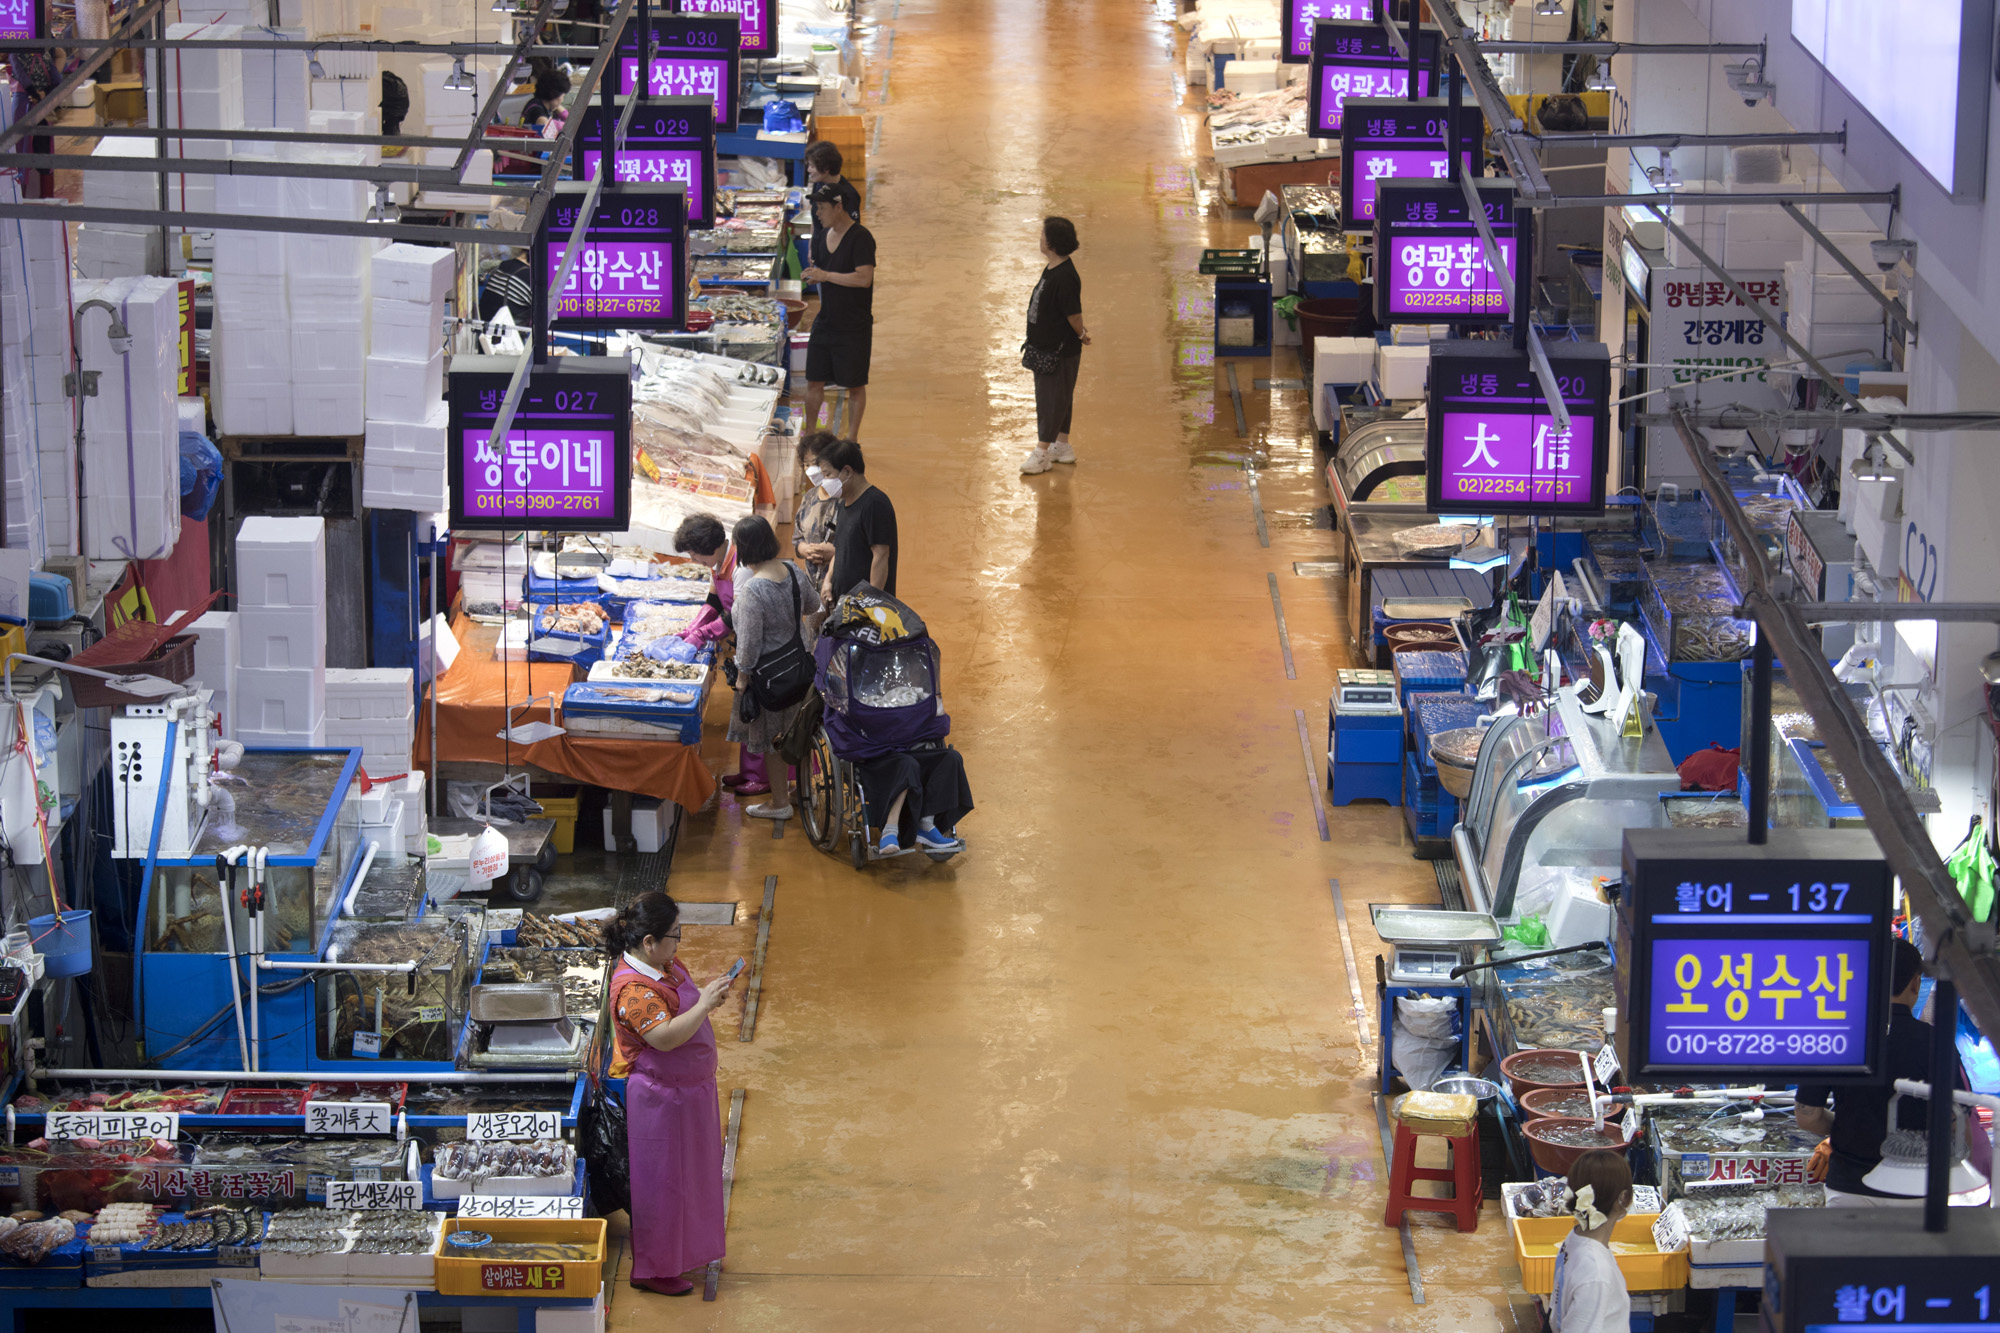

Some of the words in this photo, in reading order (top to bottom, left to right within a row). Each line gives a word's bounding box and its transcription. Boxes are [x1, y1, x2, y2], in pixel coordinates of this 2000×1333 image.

[686, 31, 717, 46] 030
[1336, 38, 1363, 54] 냉동
[655, 119, 689, 135] 029
[1367, 119, 1397, 136] 냉동
[621, 208, 658, 226] 028
[1406, 202, 1439, 221] 냉동
[1484, 203, 1504, 221] 21
[557, 298, 661, 312] 010-8927-6752
[1684, 319, 1766, 345] 간장게장
[1461, 374, 1498, 395] 냉동
[1558, 376, 1585, 396] 20
[555, 391, 598, 411] 027
[474, 439, 602, 487] 쌍둥이네
[1458, 477, 1572, 495] 02)2254-7761
[477, 495, 600, 510] 010-9090-2761
[1675, 882, 1734, 912] 활어
[1787, 883, 1850, 912] 137
[1665, 953, 1854, 1021] 오성수산
[1666, 1034, 1847, 1054] 010-8728-9880
[51, 1115, 171, 1140] 동해피문어
[472, 1113, 556, 1138] 생물오징어
[484, 1266, 524, 1288] 살아있는
[526, 1266, 563, 1288] 새우
[1833, 1284, 1906, 1322] 활어
